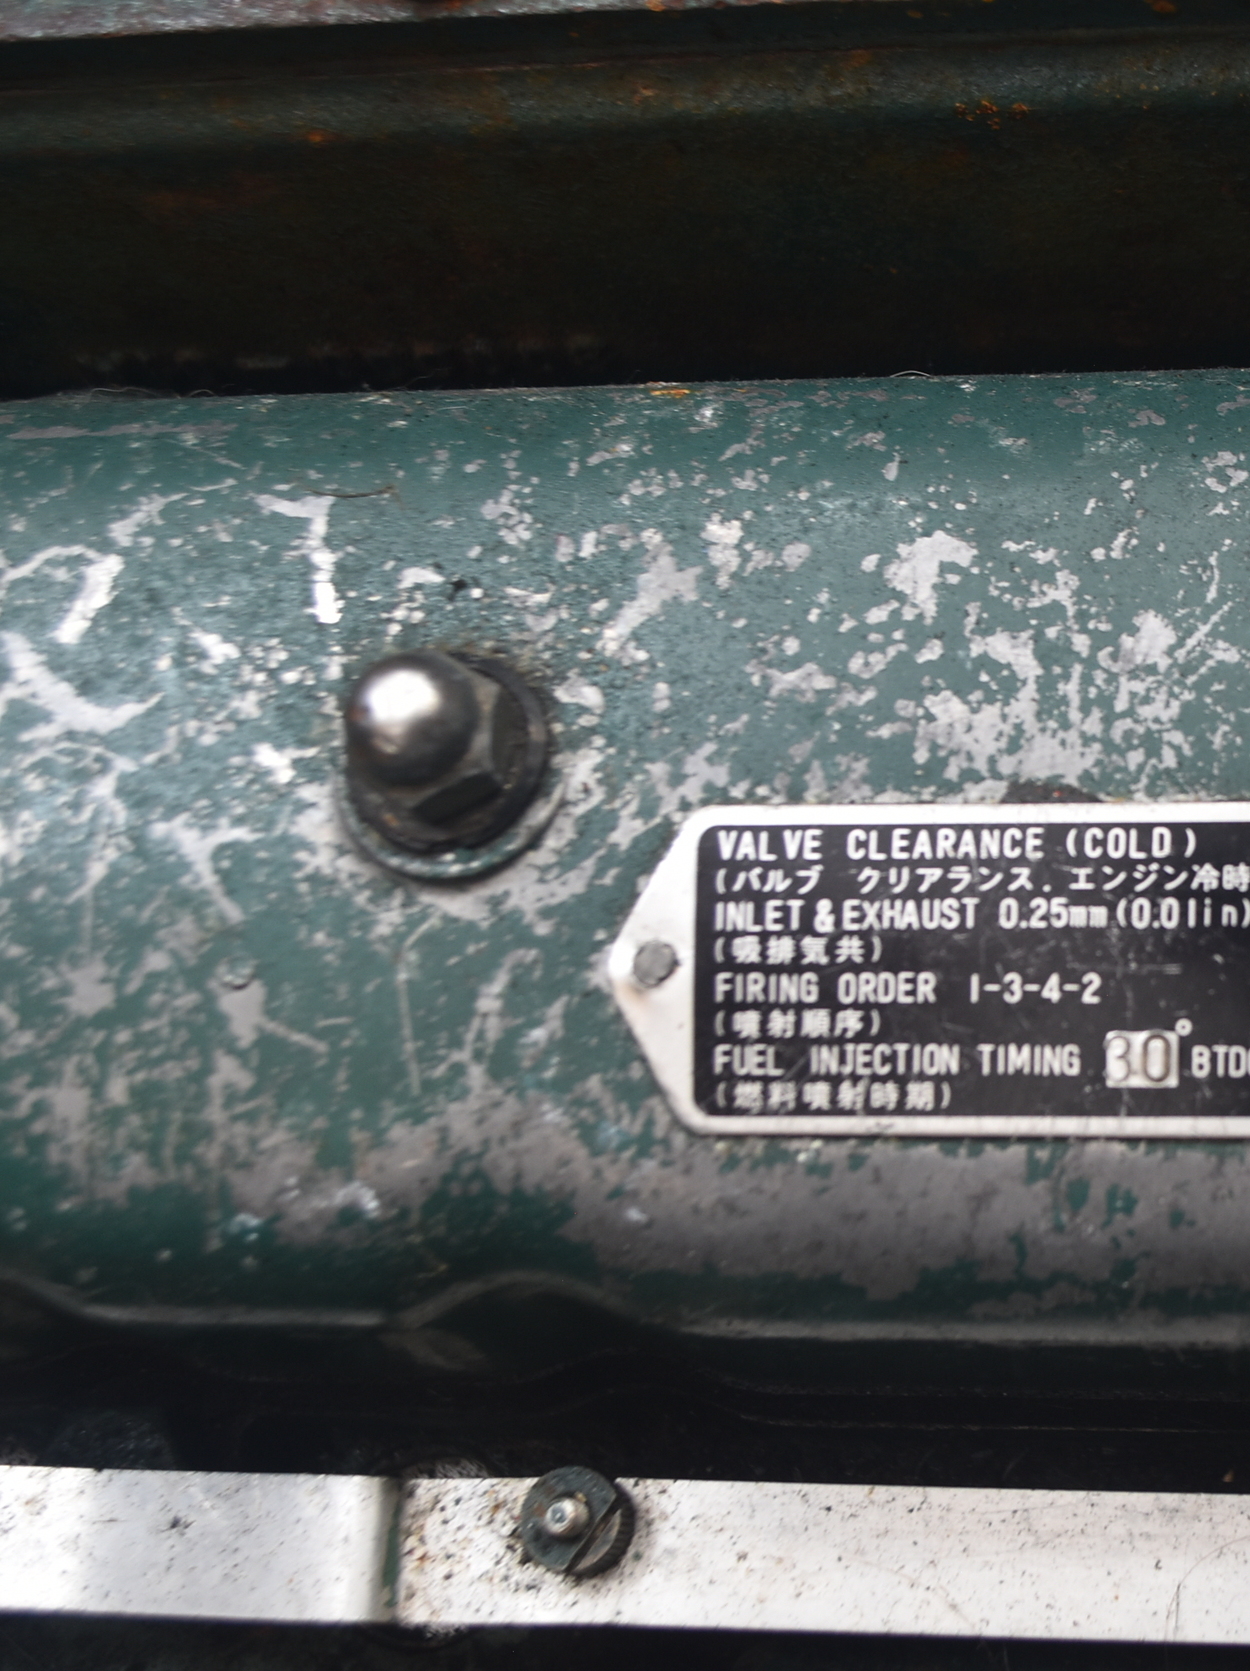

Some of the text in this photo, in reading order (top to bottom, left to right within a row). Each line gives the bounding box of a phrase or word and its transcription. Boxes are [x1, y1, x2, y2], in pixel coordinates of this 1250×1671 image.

[717, 829, 824, 861] VALVE
[846, 826, 1044, 861] CLEARANCE
[715, 899, 805, 932] INLET
[813, 898, 836, 933] &
[842, 897, 980, 931] EXHAUST
[714, 971, 1102, 1005] FIRING ORDER 1-3-4-2
[713, 1043, 785, 1077] FUEL
[810, 1042, 960, 1076] INJECTION
[976, 1042, 1081, 1077] TIMING
